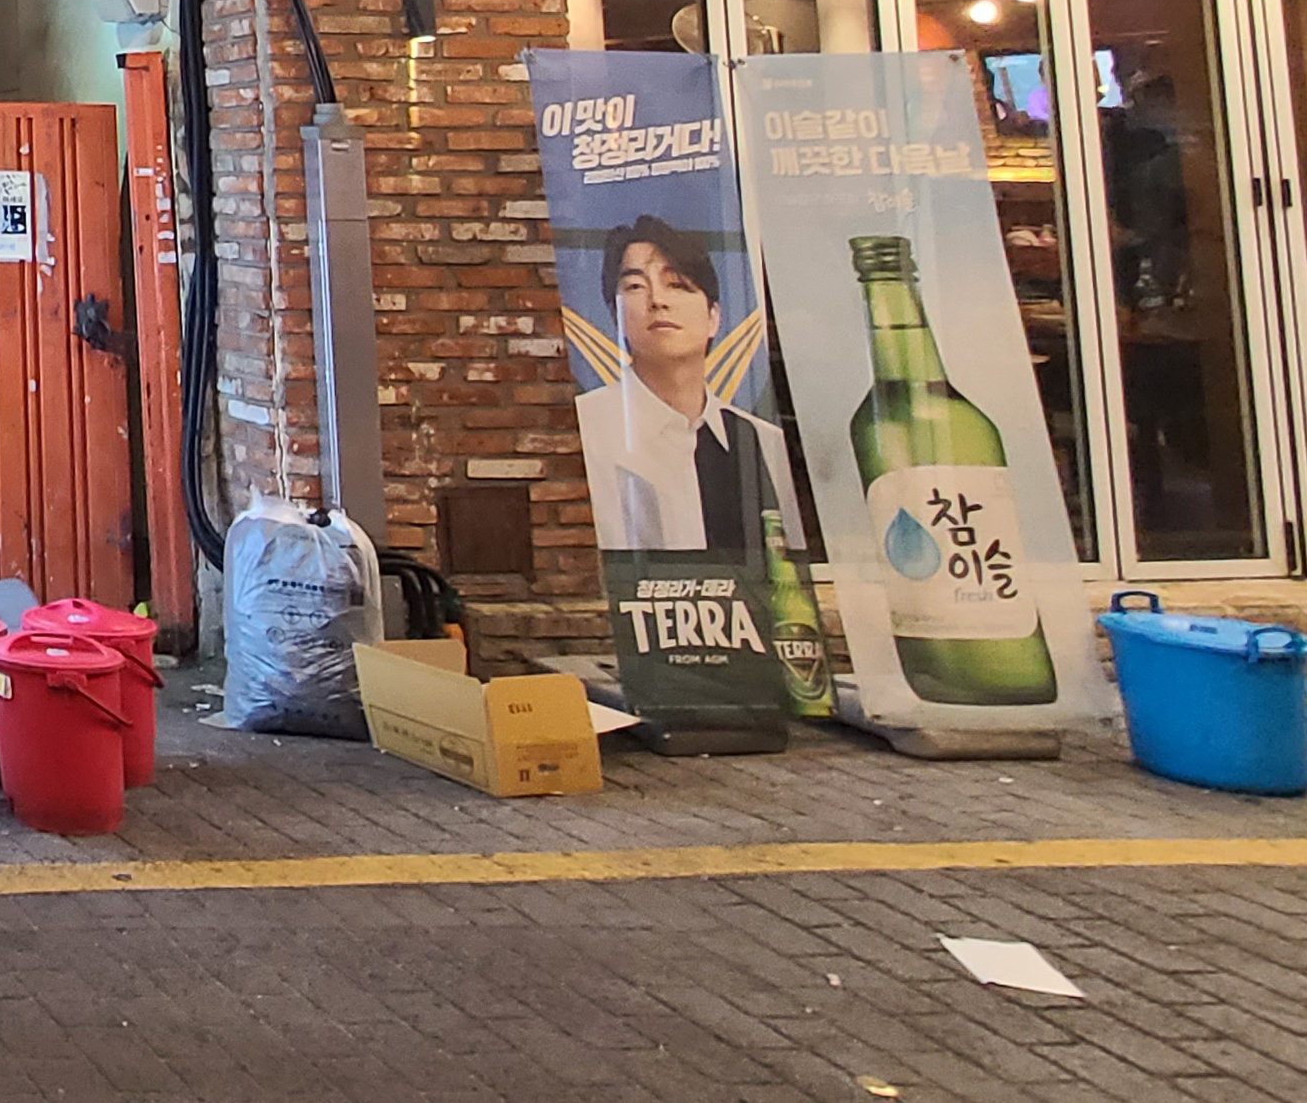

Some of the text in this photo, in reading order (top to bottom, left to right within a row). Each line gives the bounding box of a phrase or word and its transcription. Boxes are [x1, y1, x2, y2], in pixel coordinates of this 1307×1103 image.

[927, 487, 983, 546] 참
[949, 538, 1018, 599] 이슬
[619, 600, 766, 654] TERRA
[669, 654, 701, 665] FROM
